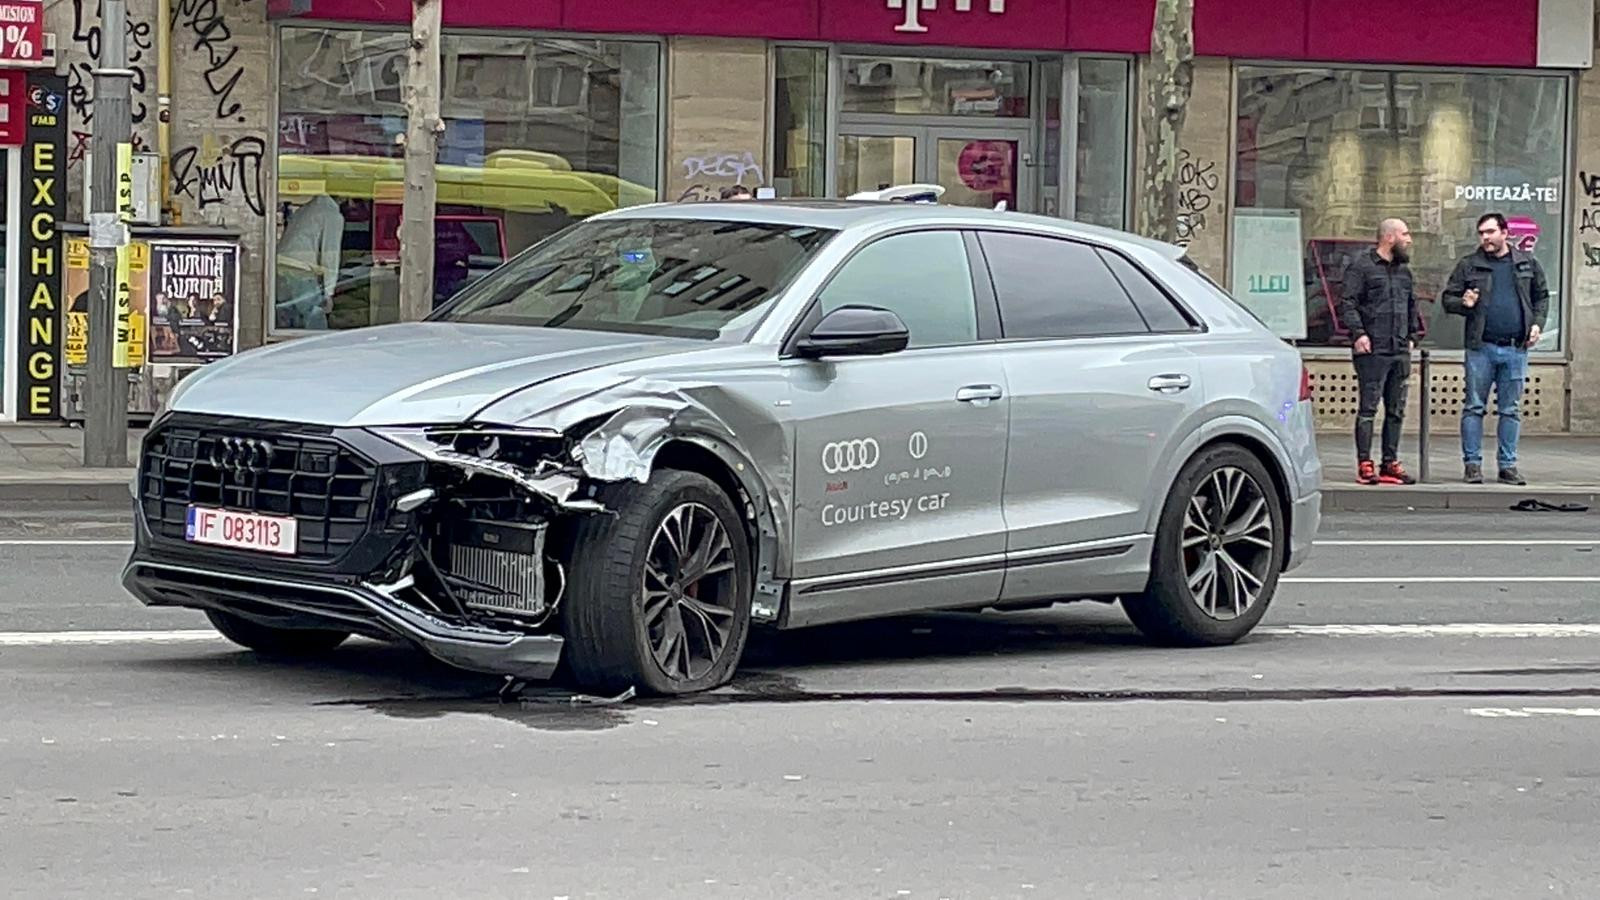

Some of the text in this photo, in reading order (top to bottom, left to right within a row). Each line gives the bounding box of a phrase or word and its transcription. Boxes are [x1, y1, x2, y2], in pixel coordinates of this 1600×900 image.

[29, 143, 55, 415] EXCHANGE
[117, 281, 131, 343] WASP
[200, 512, 281, 547] IF 083113
[821, 492, 951, 526] Courtesy car
